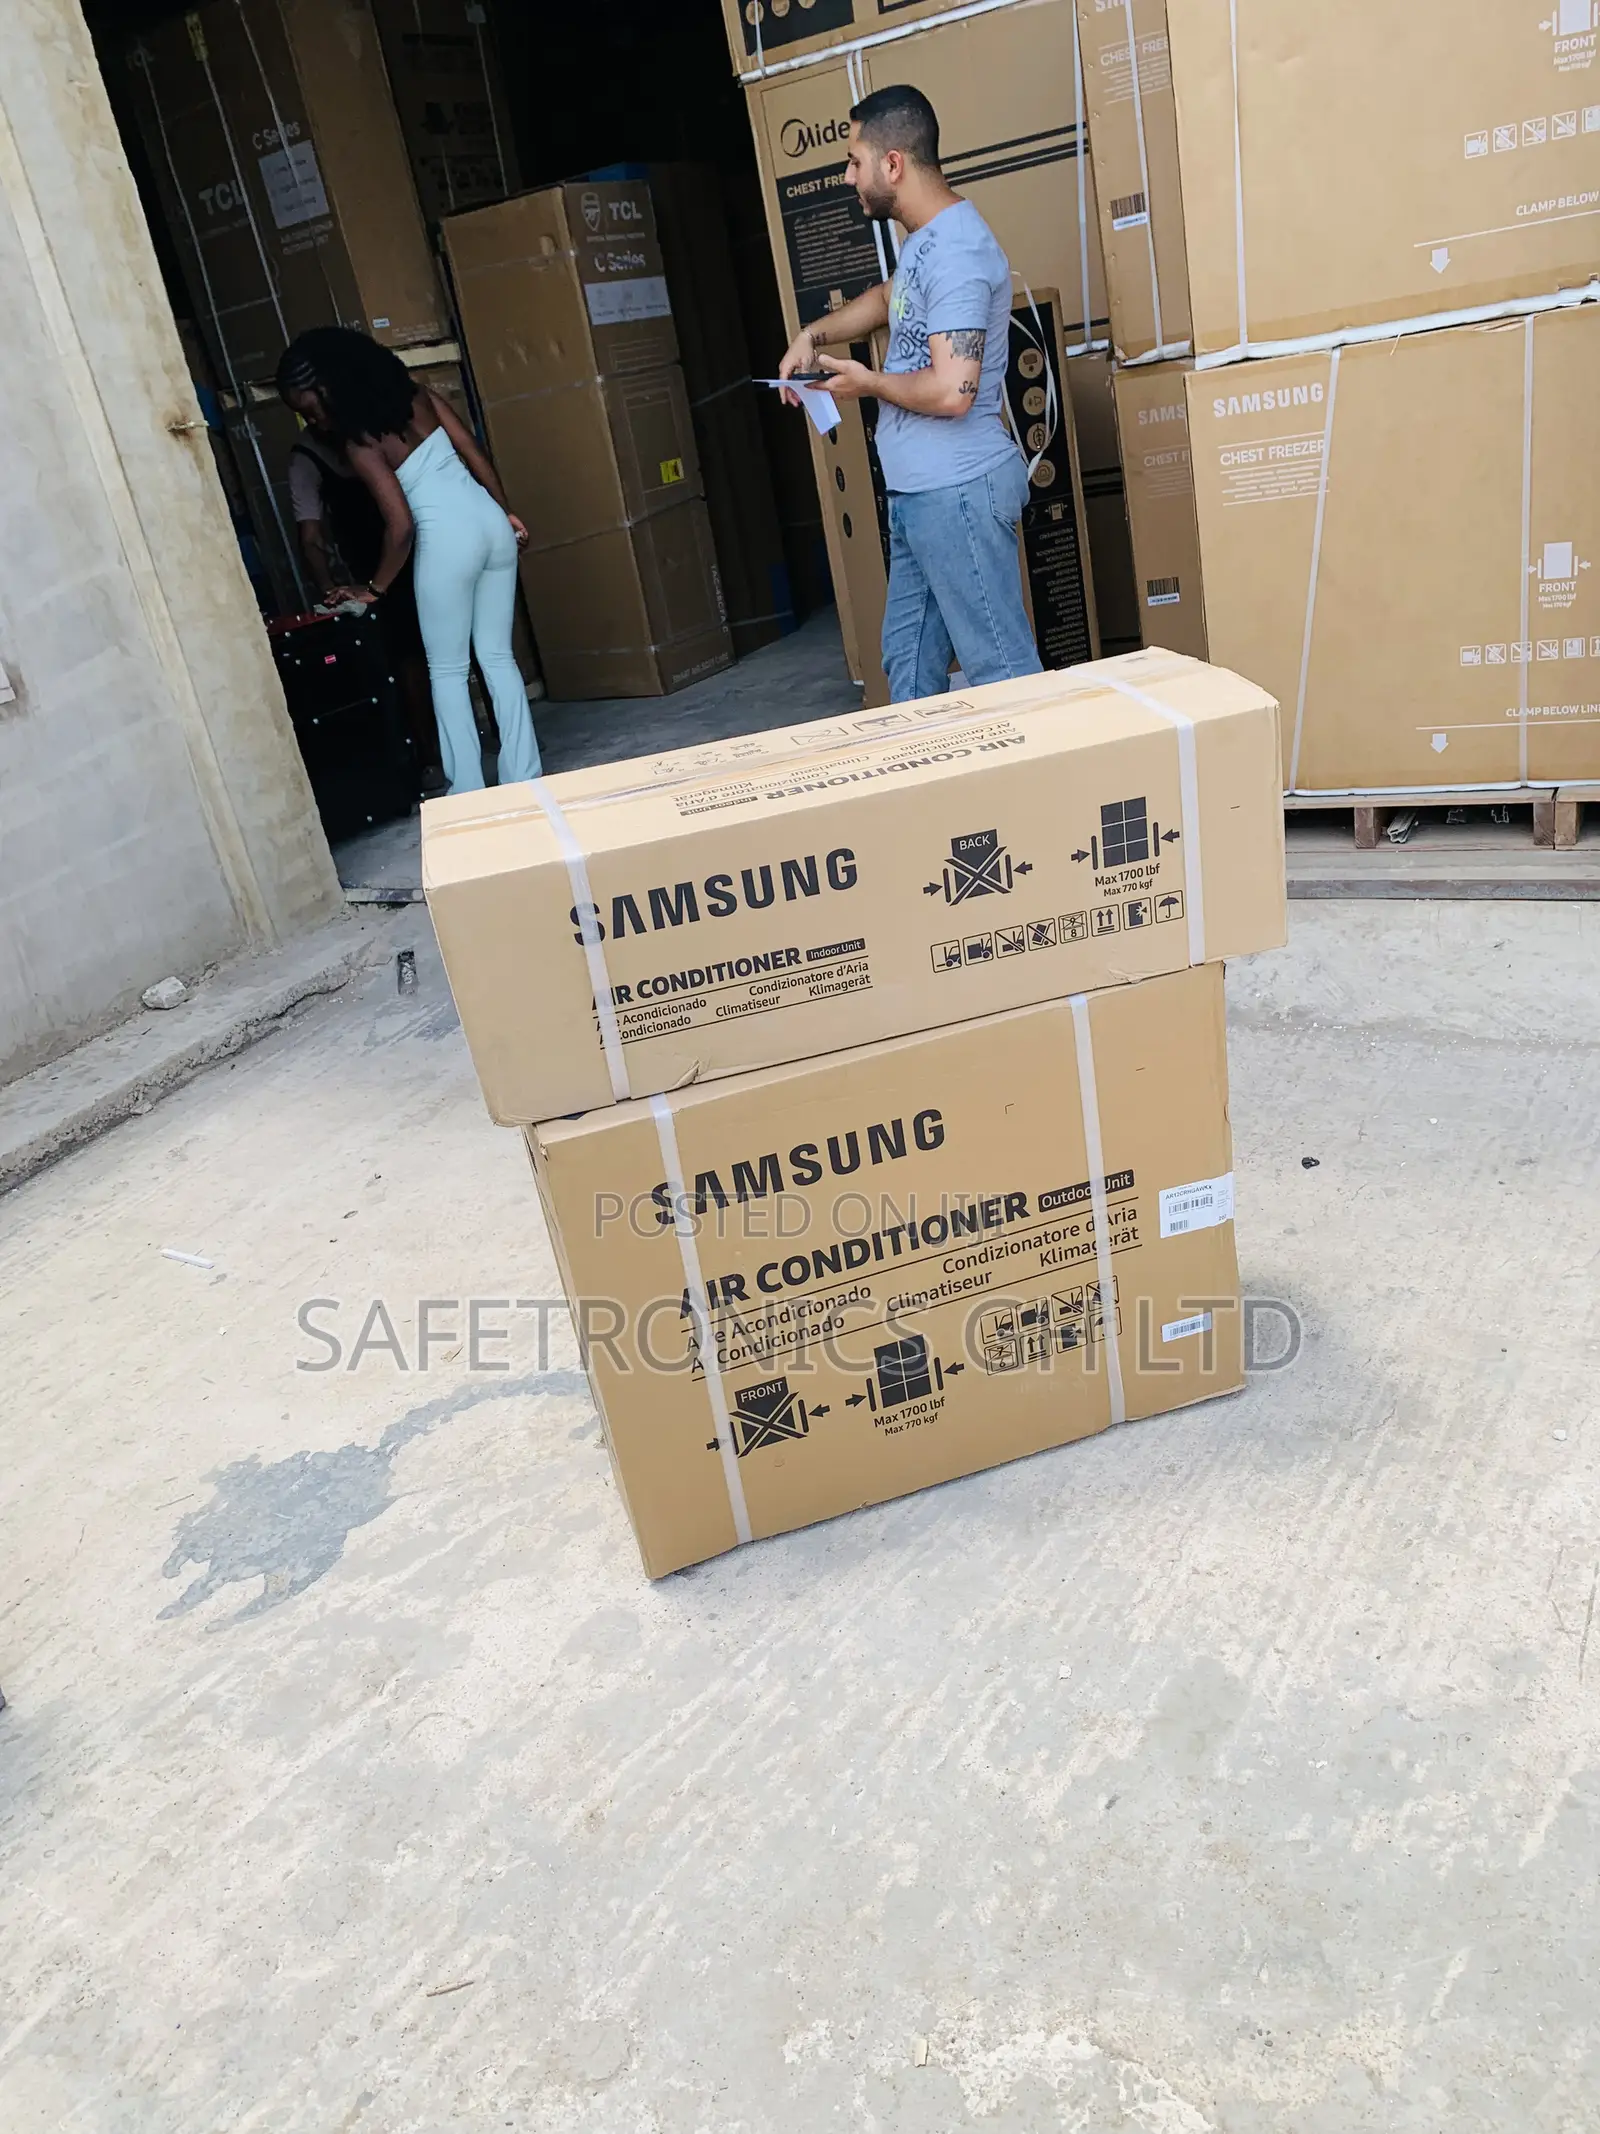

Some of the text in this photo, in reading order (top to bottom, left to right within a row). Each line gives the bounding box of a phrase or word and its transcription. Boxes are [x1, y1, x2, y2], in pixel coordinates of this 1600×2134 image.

[1101, 36, 1169, 67] CHES FREE
[1554, 33, 1597, 53] FRONT
[780, 118, 851, 158] Mide
[197, 179, 244, 217] TCL
[786, 172, 846, 198] CHEST FRE
[608, 200, 643, 221] TCL
[1515, 190, 1600, 217] CLAMP BELOW
[1213, 382, 1324, 418] SAMSUNG
[1137, 403, 1187, 426] SAMS
[1143, 451, 1180, 468] CHEST
[1220, 447, 1265, 466] CHEST
[1538, 581, 1577, 593] FRONT
[1543, 703, 1580, 715] BELOW
[1581, 703, 1600, 714] LIN
[764, 735, 1026, 801] AIR CONDITIONER
[959, 834, 991, 851] BACK
[1094, 862, 1161, 887] Max 1700 lbf
[1103, 878, 1154, 897] Max 770 kgf
[569, 847, 859, 946] SAMSUNG
[810, 940, 862, 960] Indoor Unit
[591, 946, 803, 1011] IR CONDITIONER
[622, 997, 707, 1026] Acondicionado
[748, 970, 834, 996] Condizionatore
[836, 961, 869, 977] d'Aria
[619, 1015, 692, 1041] ondicionado
[715, 993, 781, 1018] Climatiseur
[808, 973, 871, 997] Klimagerät
[650, 1108, 946, 1226] SAMSUNG
[1041, 1184, 1095, 1209] Outdoo
[756, 1190, 1031, 1294] CONDITIONER
[731, 1285, 872, 1340] Acondicionado
[942, 1224, 1081, 1274] Condizionatore
[716, 1315, 846, 1365] Condicionado
[886, 1270, 993, 1314] Climatiseur
[740, 1380, 784, 1403] FRONT
[873, 1396, 946, 1428] Max 1700 lbf
[884, 1412, 939, 1436] Max 770 kgf
